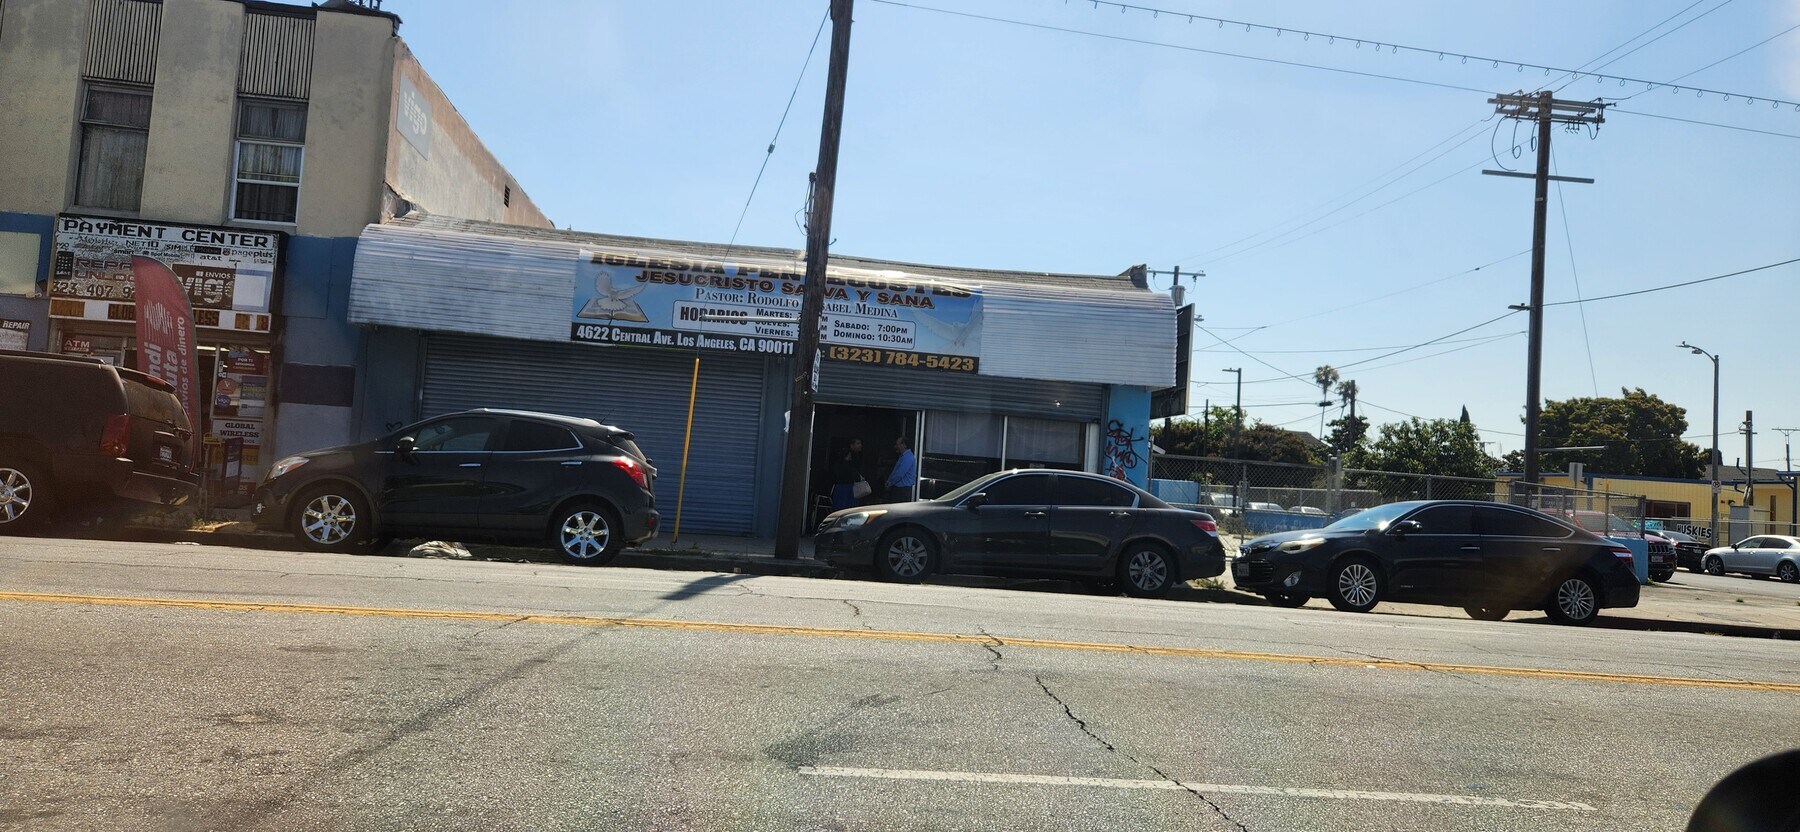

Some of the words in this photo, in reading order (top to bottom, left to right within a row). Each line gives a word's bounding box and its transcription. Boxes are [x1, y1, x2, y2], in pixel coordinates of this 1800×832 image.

[64, 219, 166, 239] PAYMENT
[181, 229, 268, 248] CENTER
[86, 284, 114, 297] 407
[635, 270, 775, 293] JESUCRISTO
[781, 282, 850, 301] SAVA
[856, 289, 872, 303] Y
[876, 291, 935, 309] SANA
[695, 288, 743, 303] PASTOR:
[747, 292, 799, 308] RODOLFO
[855, 303, 898, 319] MEDINA
[756, 309, 792, 319] MARTES:
[3, 320, 31, 330] REPAIR
[755, 326, 794, 337] VIERNES:
[834, 320, 870, 331] SABADO:
[877, 323, 908, 335] 7:00PM
[177, 316, 187, 356] dinero
[576, 325, 610, 341] 4622
[611, 328, 651, 344] CENTRAL
[653, 331, 675, 345] AVE.
[677, 333, 695, 348] LOS
[696, 334, 738, 351] ANGELES,
[739, 338, 756, 352] CA
[758, 340, 794, 355] 90011
[833, 329, 875, 341] DOMINGO:
[877, 334, 913, 344] 10:30AM
[65, 340, 90, 348] ATM
[829, 346, 881, 363] (323)
[886, 351, 975, 372] 784-5423
[225, 422, 256, 430] GLOBAL
[220, 430, 260, 438] WIRELESS
